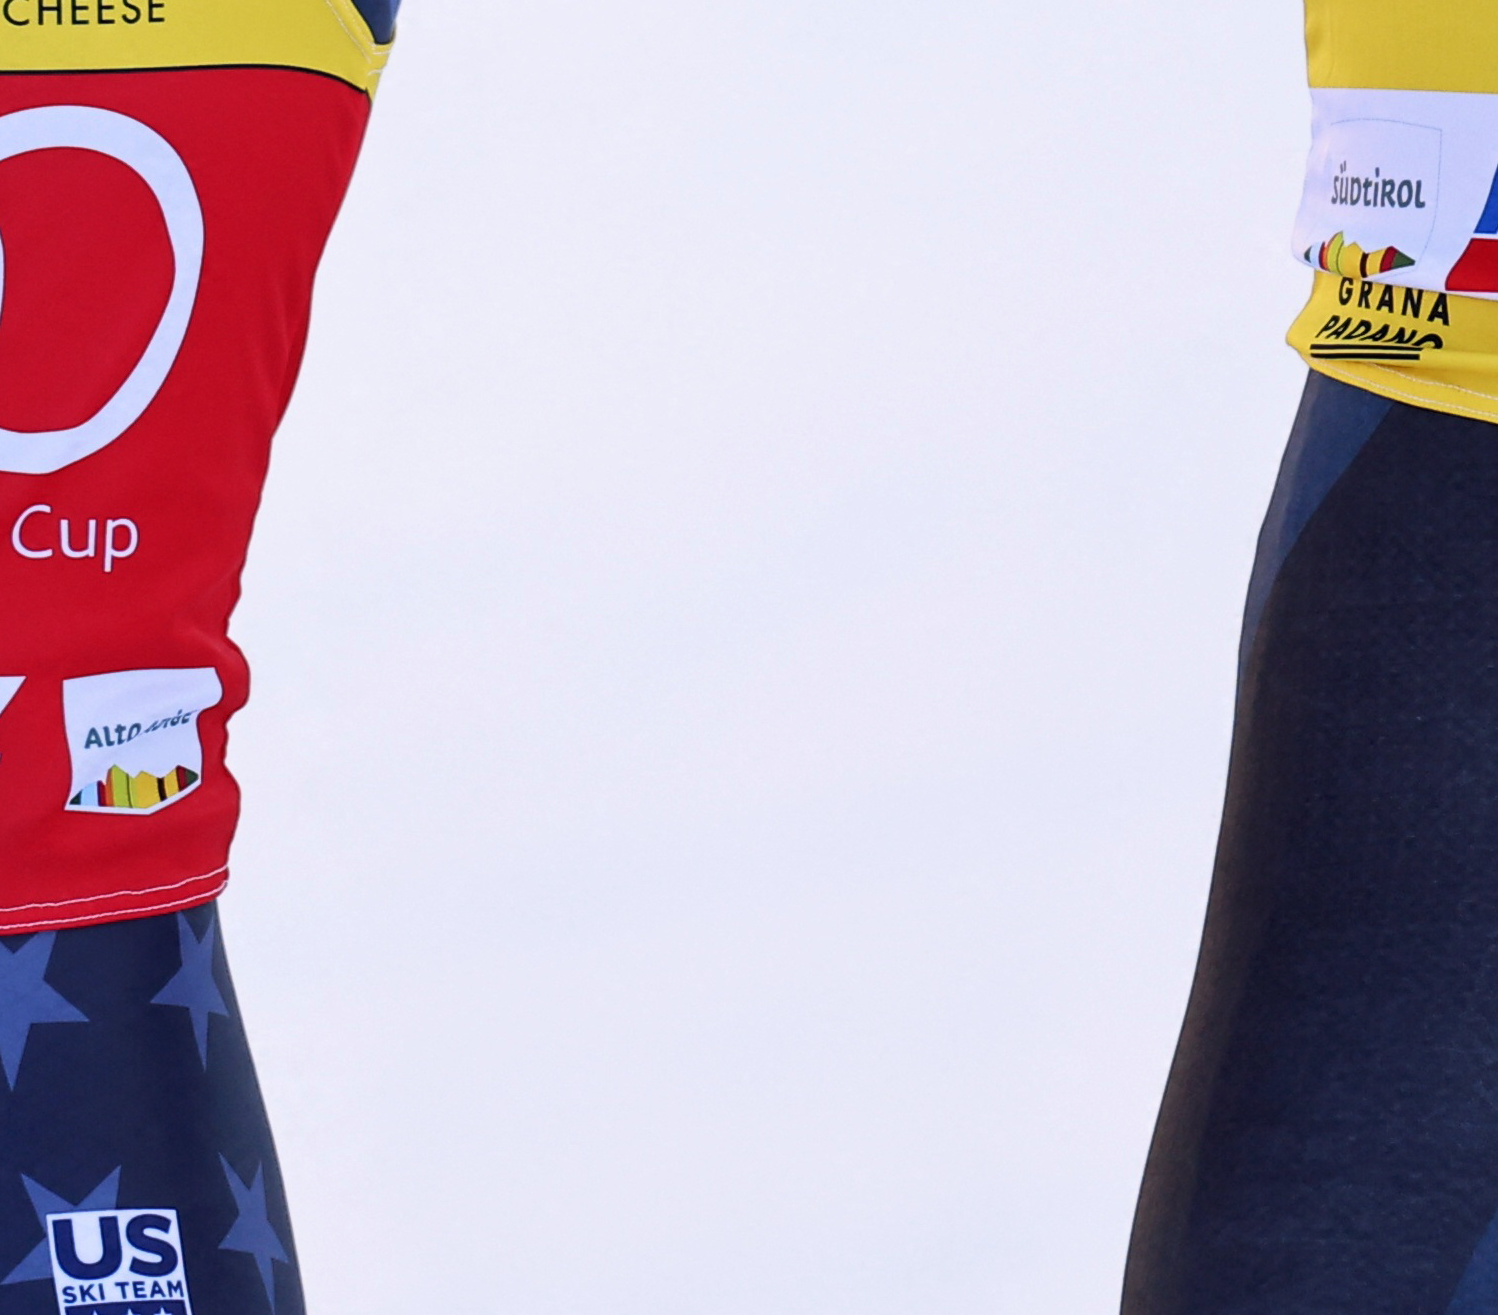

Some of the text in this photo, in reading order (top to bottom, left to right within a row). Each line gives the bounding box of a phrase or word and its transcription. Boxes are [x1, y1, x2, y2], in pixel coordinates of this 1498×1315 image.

[1339, 276, 1450, 326] GRANA
[12, 504, 140, 573] Cup
[52, 1213, 179, 1280] US
[62, 1279, 185, 1304] SKI TEAM
